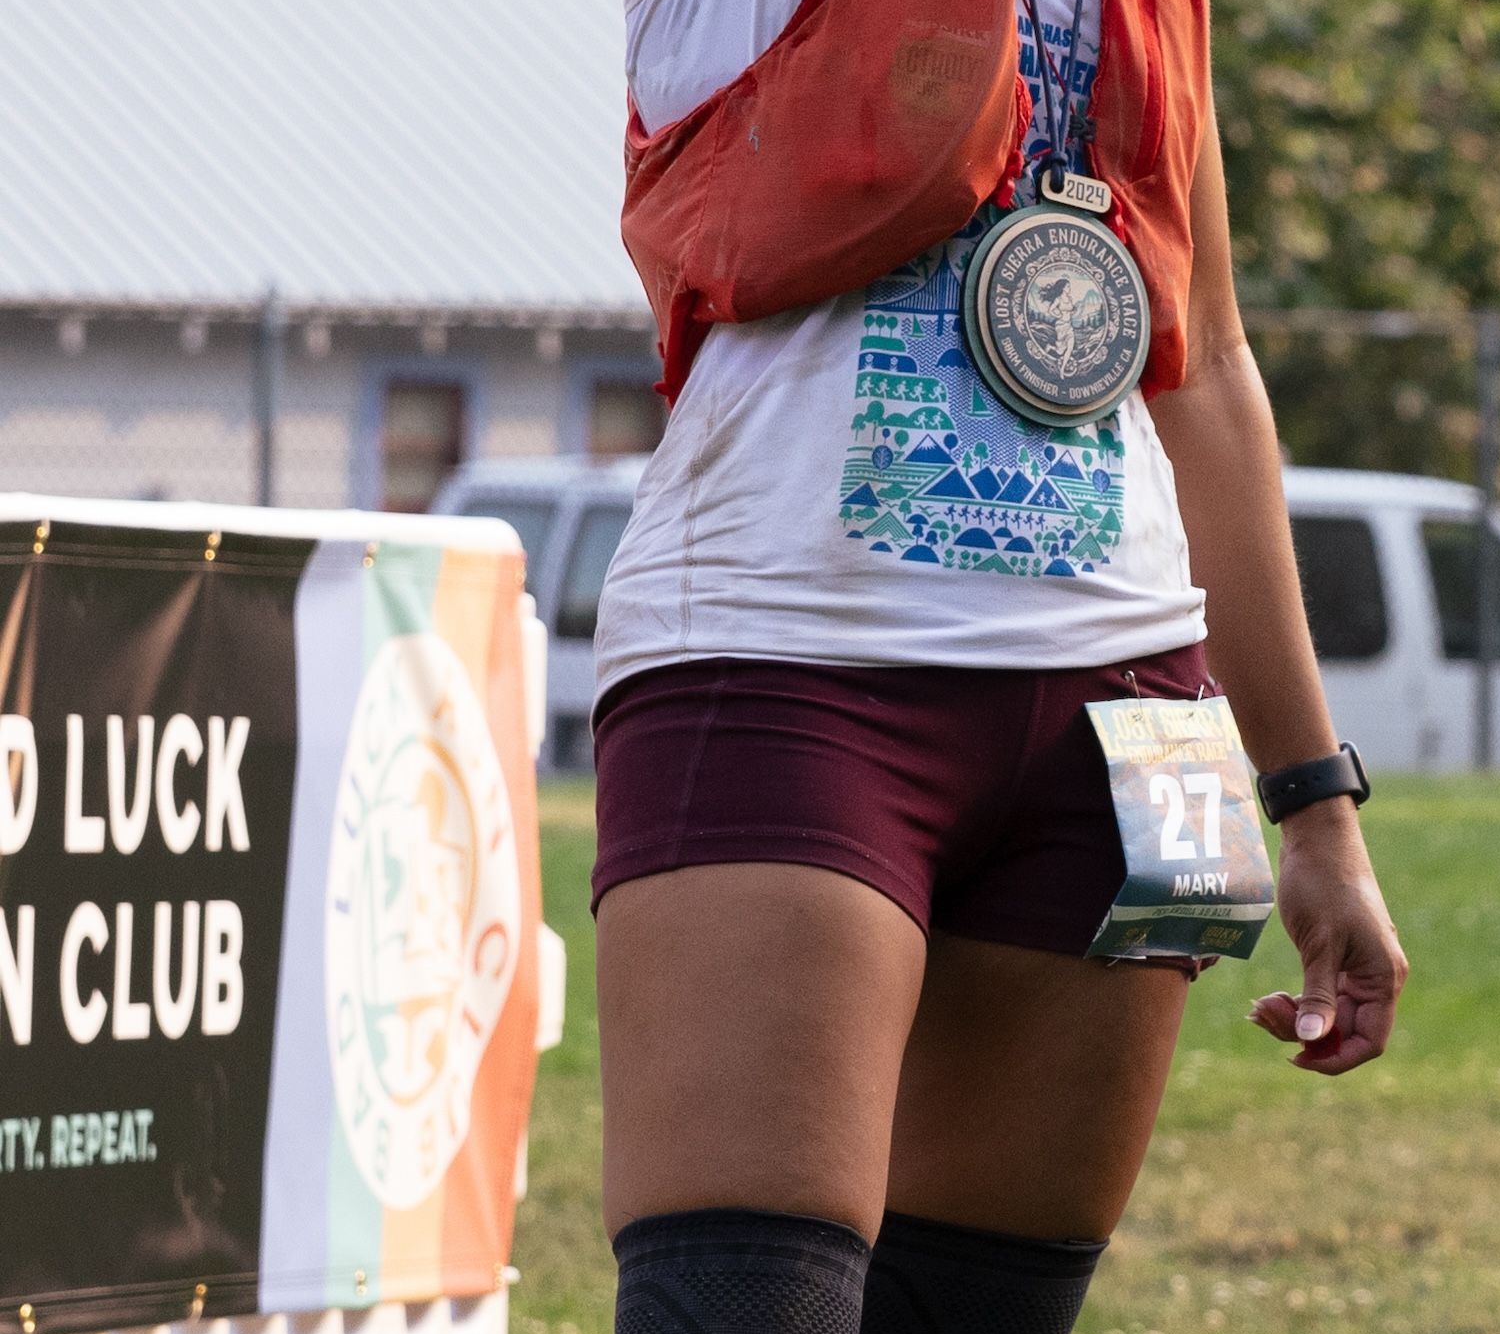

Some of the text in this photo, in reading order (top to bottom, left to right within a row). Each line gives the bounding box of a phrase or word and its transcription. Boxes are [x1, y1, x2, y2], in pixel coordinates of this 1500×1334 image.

[1066, 179, 1105, 206] 2024
[995, 228, 1138, 339] LOST SIERRA ENDURANCE RACE
[1019, 365, 1059, 397] FINISHER
[1069, 362, 1125, 399] DOWNIEVILLE
[1120, 348, 1133, 363] CA
[0, 713, 251, 855] D LUCK
[1150, 772, 1223, 861] 27
[1172, 872, 1229, 897] MARY
[0, 900, 244, 1046] N CLUB
[0, 1109, 157, 1173] TY. REPEAT.
